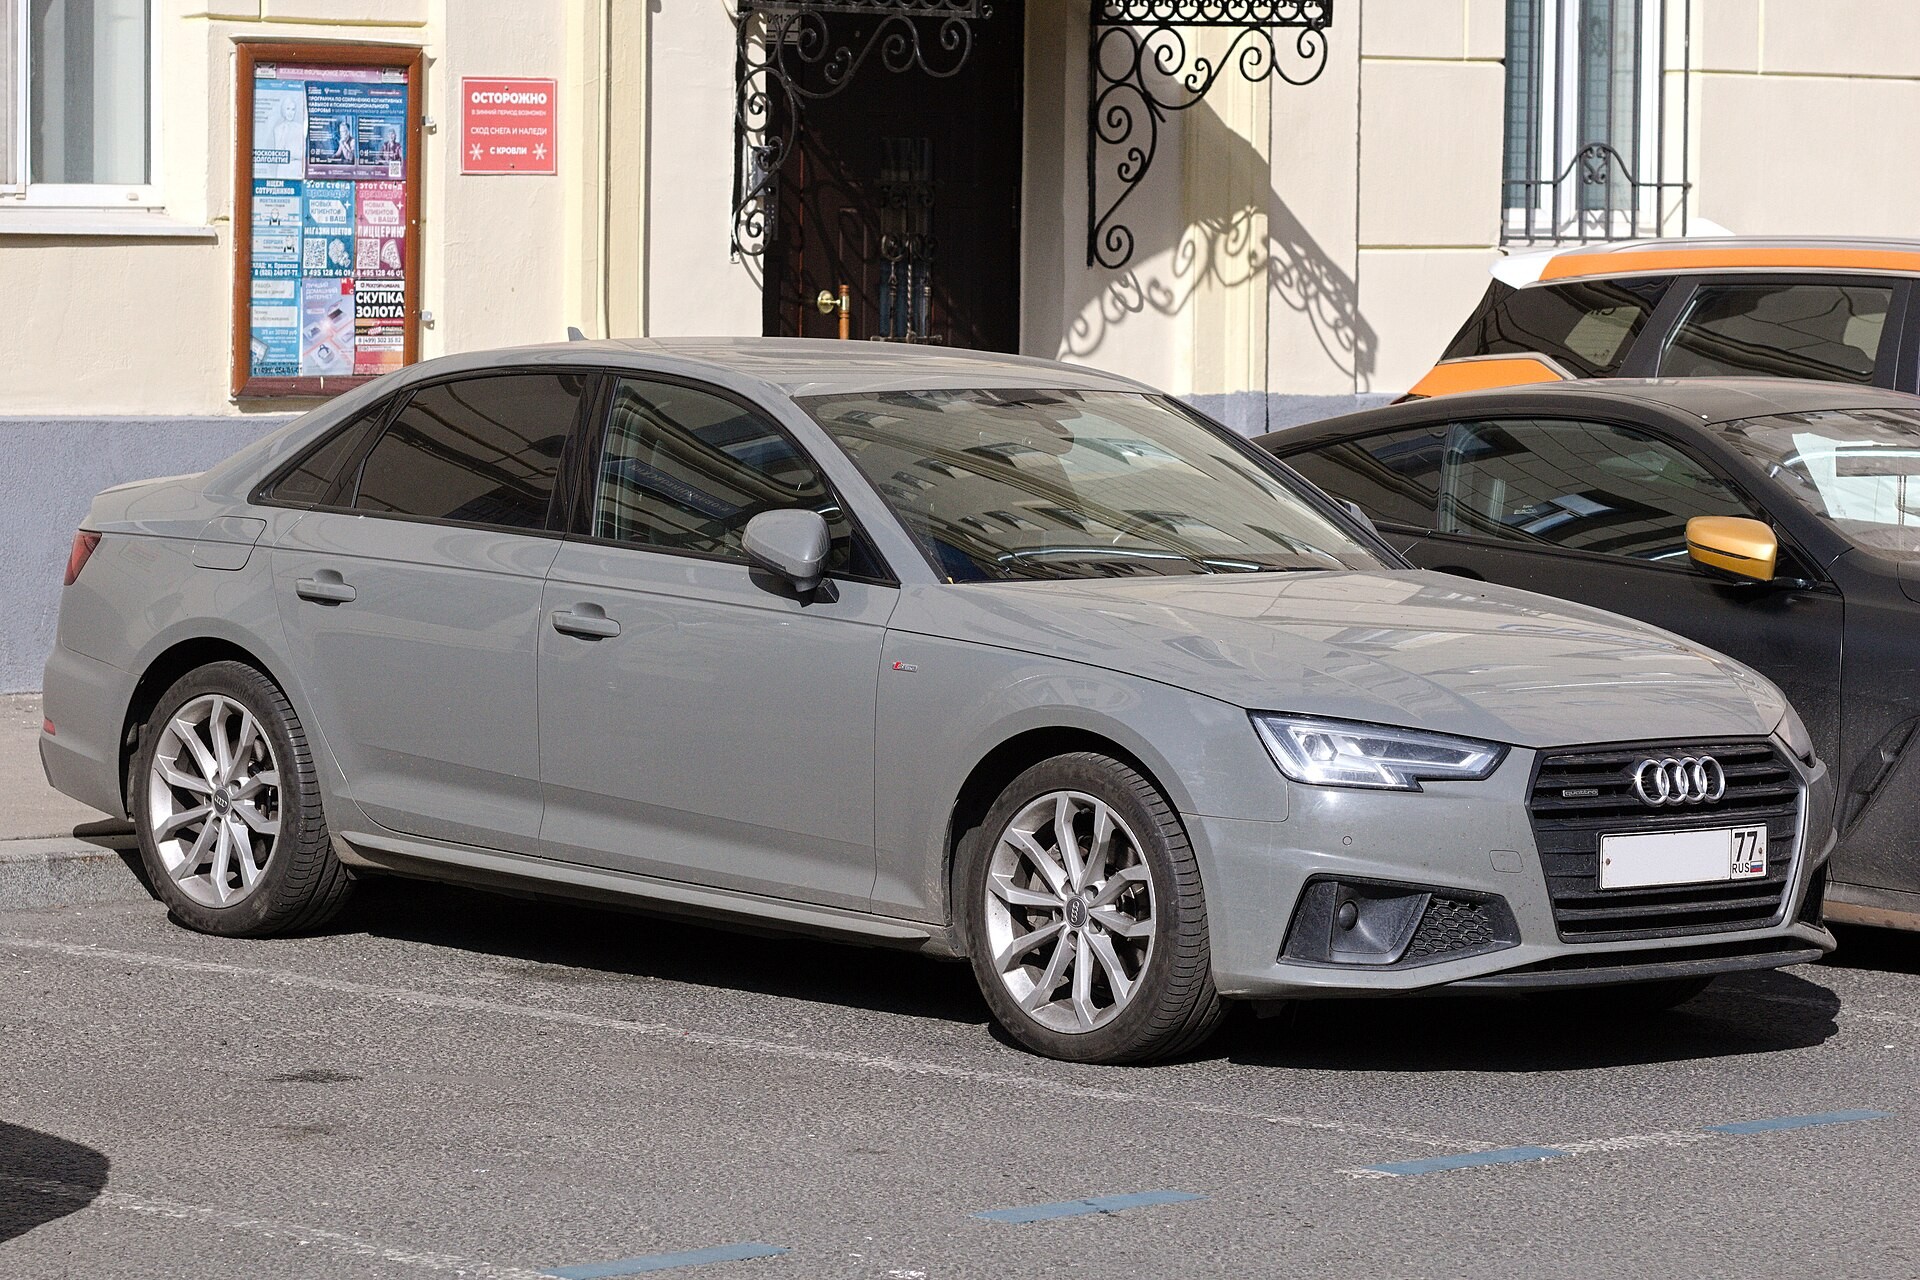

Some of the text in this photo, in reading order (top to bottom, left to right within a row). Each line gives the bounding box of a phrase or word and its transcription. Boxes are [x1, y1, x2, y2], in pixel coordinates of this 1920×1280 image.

[471, 92, 547, 104] ОСТОРОЖНО
[470, 127, 490, 135] СХОД
[490, 146, 527, 155] С КРОВЛИ
[358, 226, 404, 238] ПИЦЦЕРИЮ
[356, 292, 404, 304] СКУПКА
[356, 306, 404, 318] ЗОЛОТА
[1734, 831, 1758, 862] 77
[1732, 862, 1750, 874] RUS
